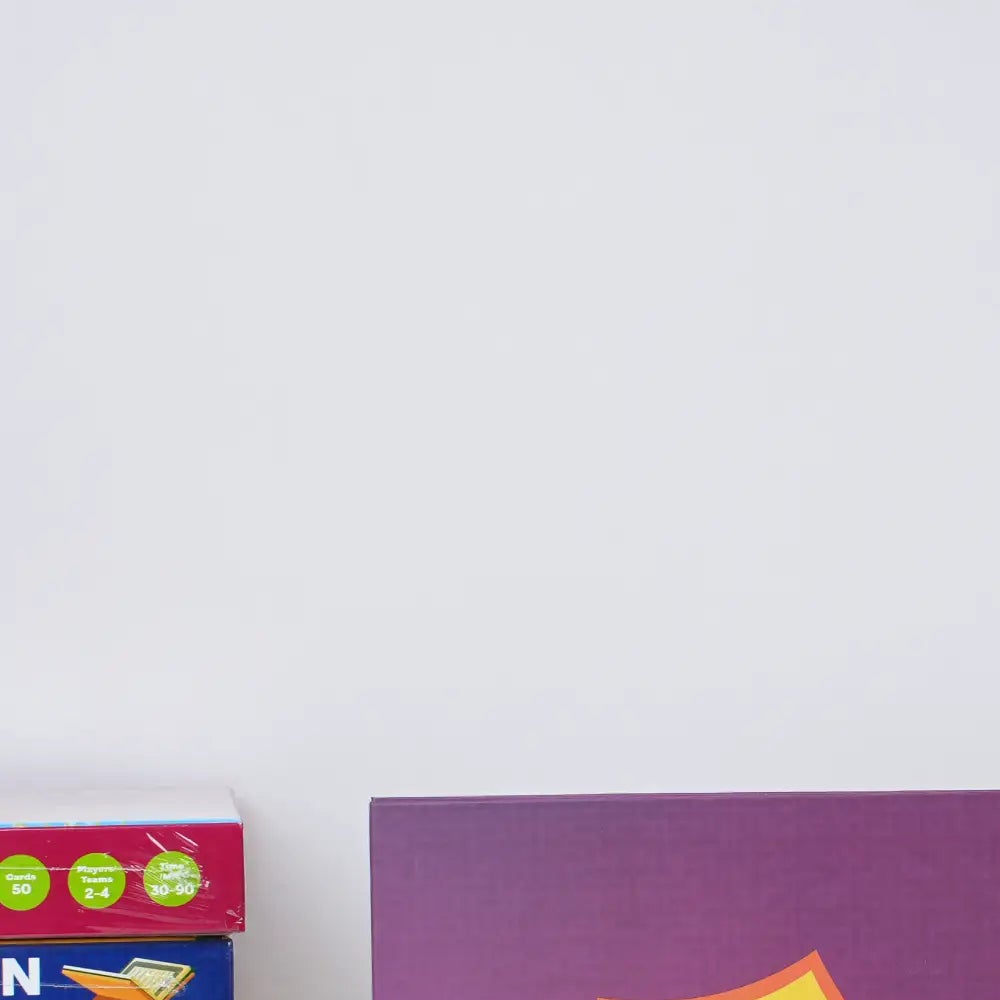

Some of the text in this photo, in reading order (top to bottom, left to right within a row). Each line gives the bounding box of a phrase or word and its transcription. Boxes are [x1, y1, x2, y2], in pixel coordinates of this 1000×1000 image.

[5, 873, 37, 881] Cards
[12, 884, 32, 895] 50
[84, 887, 111, 899] 2-4
[151, 883, 195, 896] 30-90
